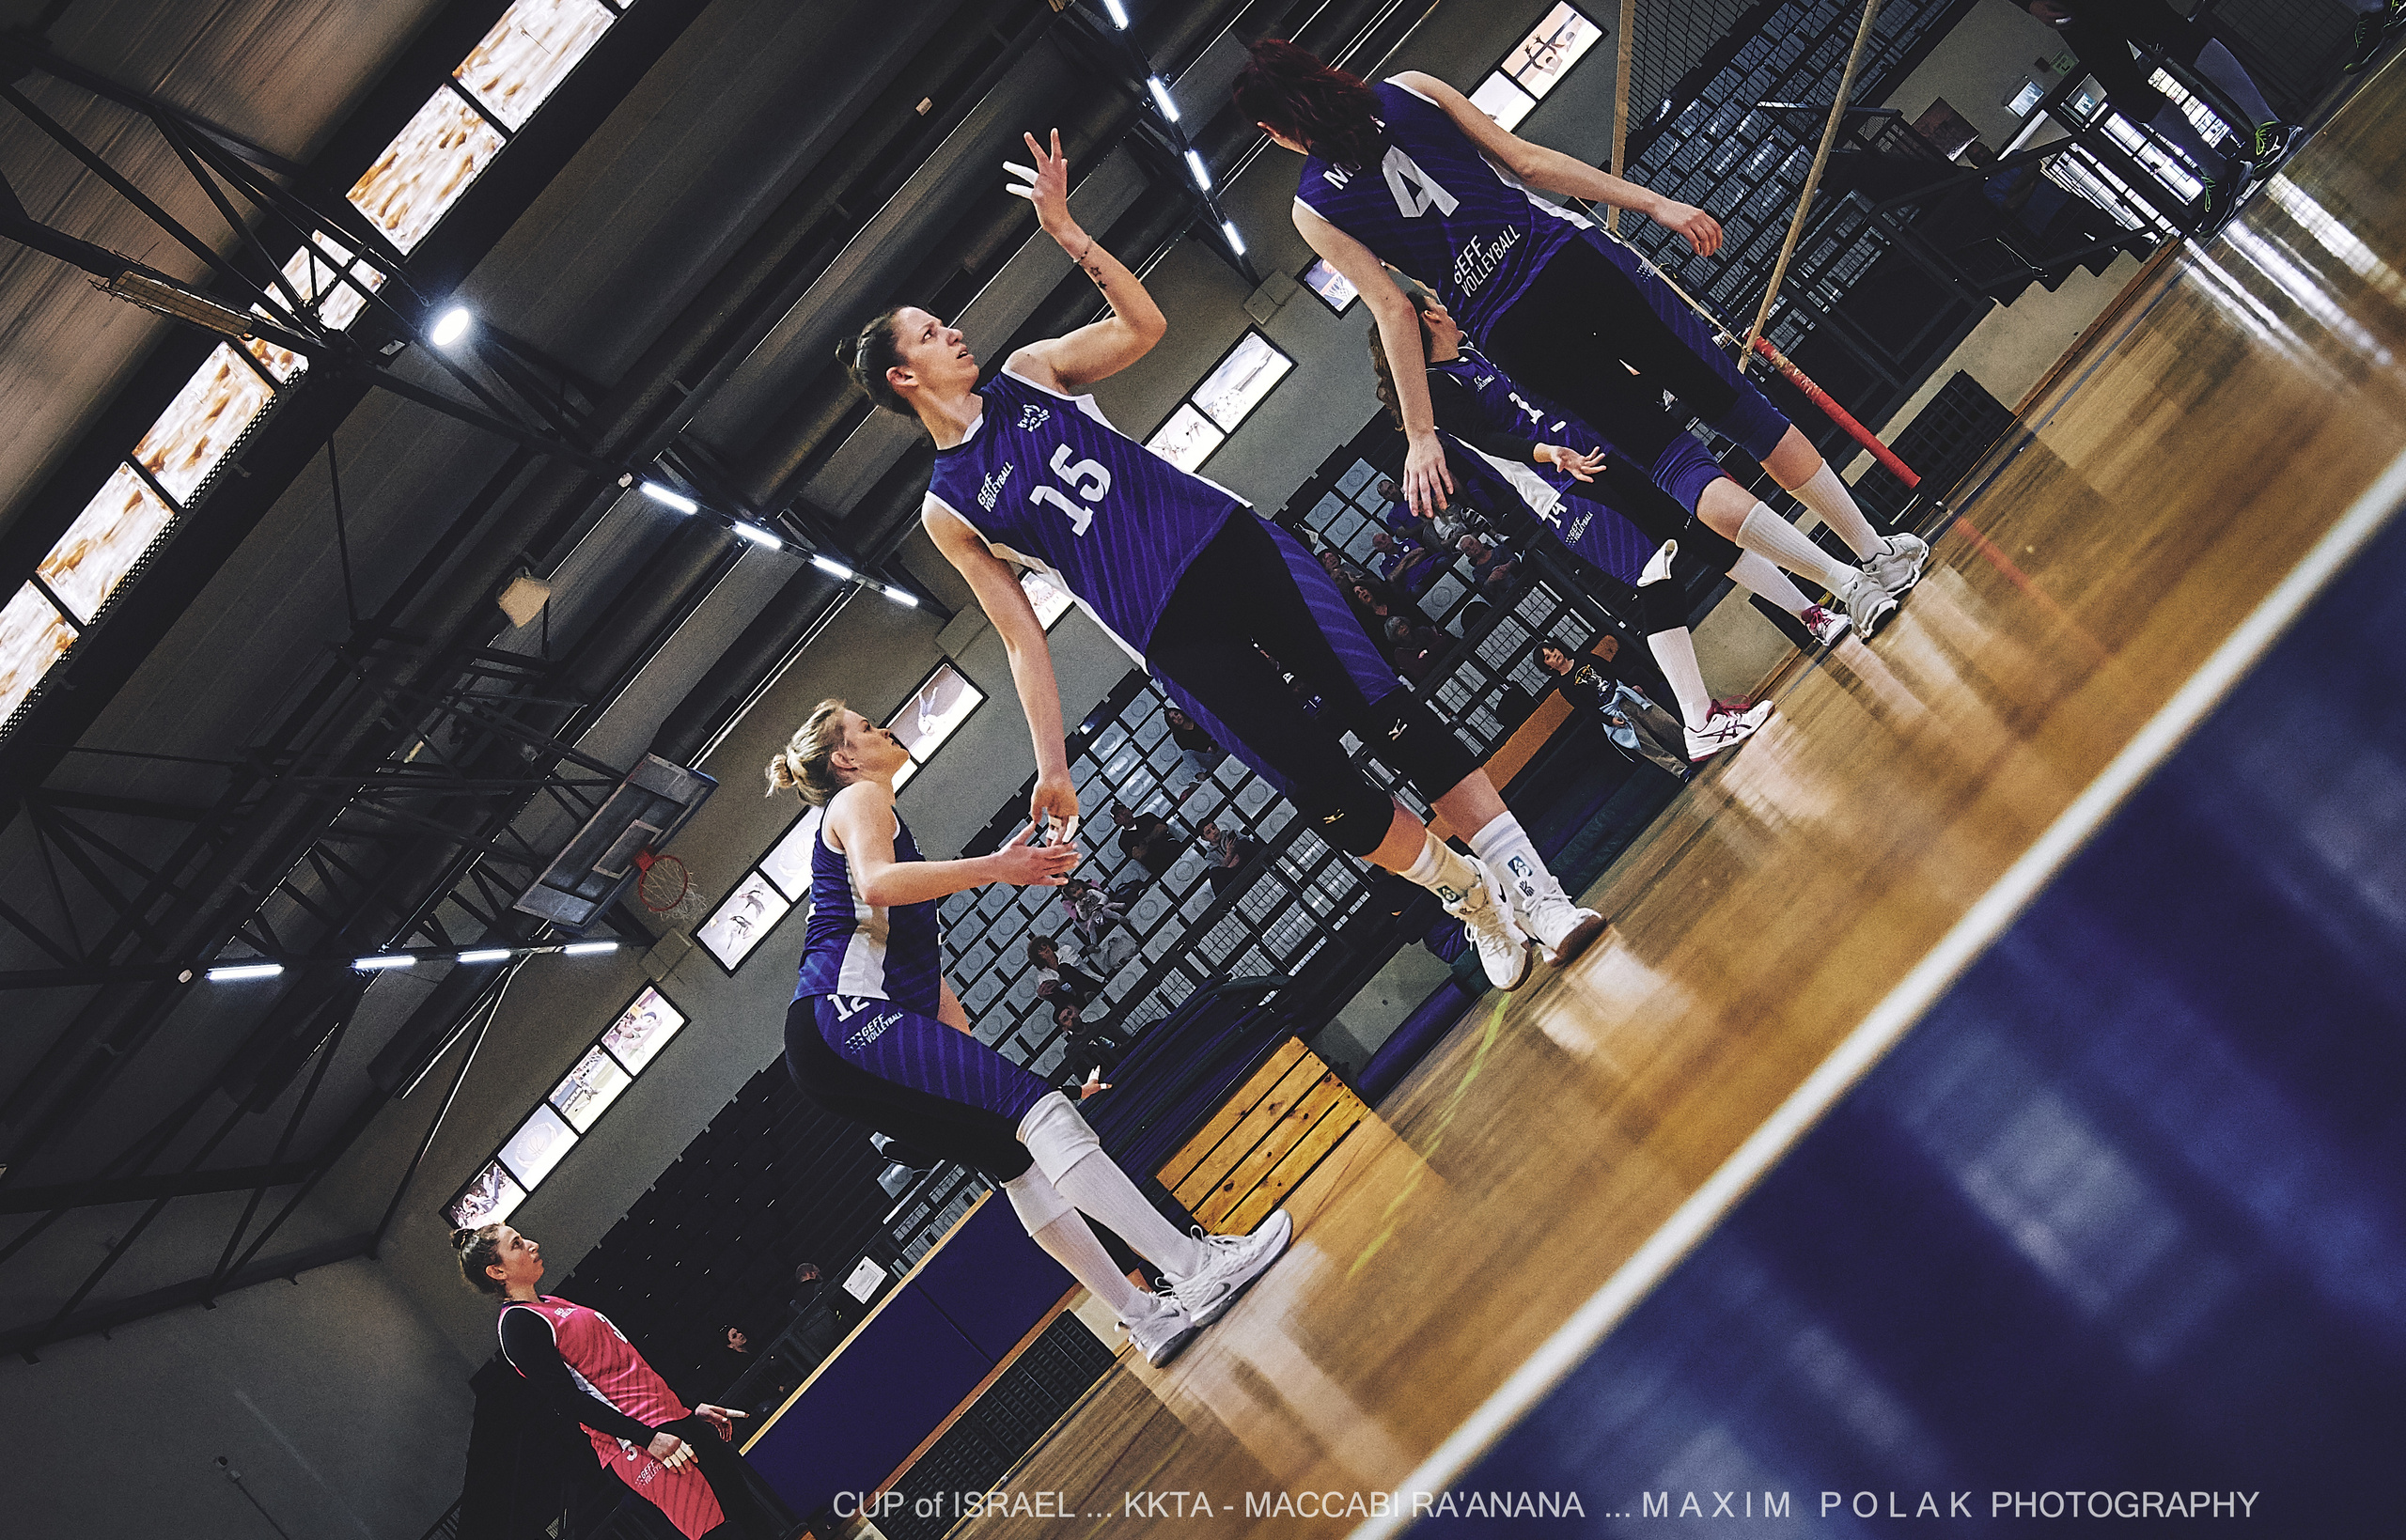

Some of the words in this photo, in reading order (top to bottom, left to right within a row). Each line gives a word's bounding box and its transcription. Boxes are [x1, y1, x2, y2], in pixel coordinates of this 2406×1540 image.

[1381, 145, 1460, 217] 4
[1461, 225, 1521, 298] VOLLEYBALL
[977, 472, 992, 506] GEFF
[984, 461, 1014, 512] VOLLEYBALL
[1029, 443, 1112, 537] 15
[1570, 516, 1581, 537] GEFF
[827, 994, 870, 1022] 12
[862, 1014, 883, 1037] GEFF
[866, 1012, 903, 1044] VOLLEYBALL
[641, 1458, 654, 1479] GEFF
